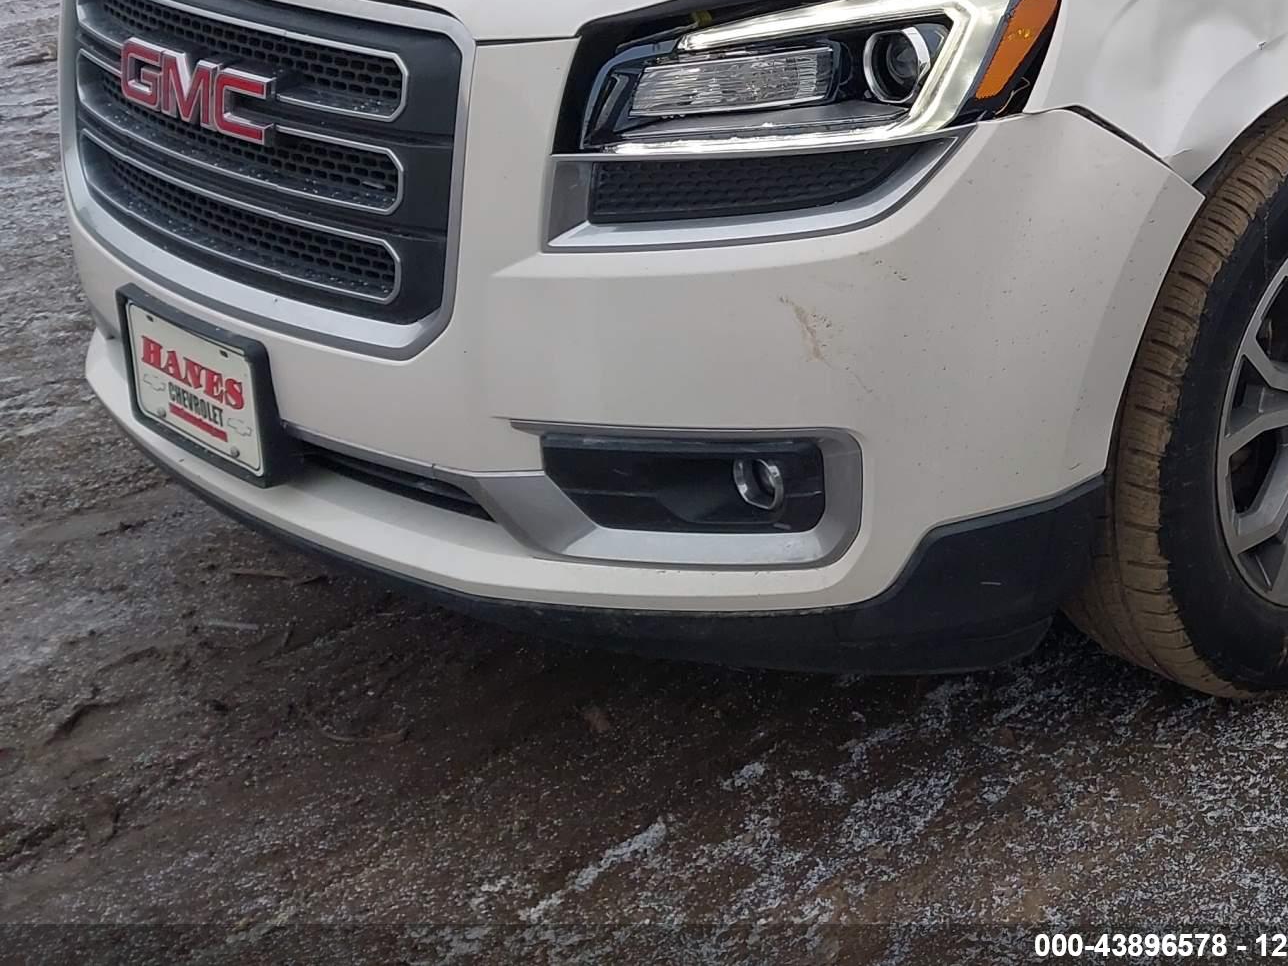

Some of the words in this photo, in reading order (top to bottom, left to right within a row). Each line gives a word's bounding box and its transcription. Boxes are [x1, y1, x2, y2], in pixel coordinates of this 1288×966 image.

[121, 36, 277, 146] GMC
[141, 335, 245, 410] HANES
[168, 381, 224, 427] CHEVROLET
